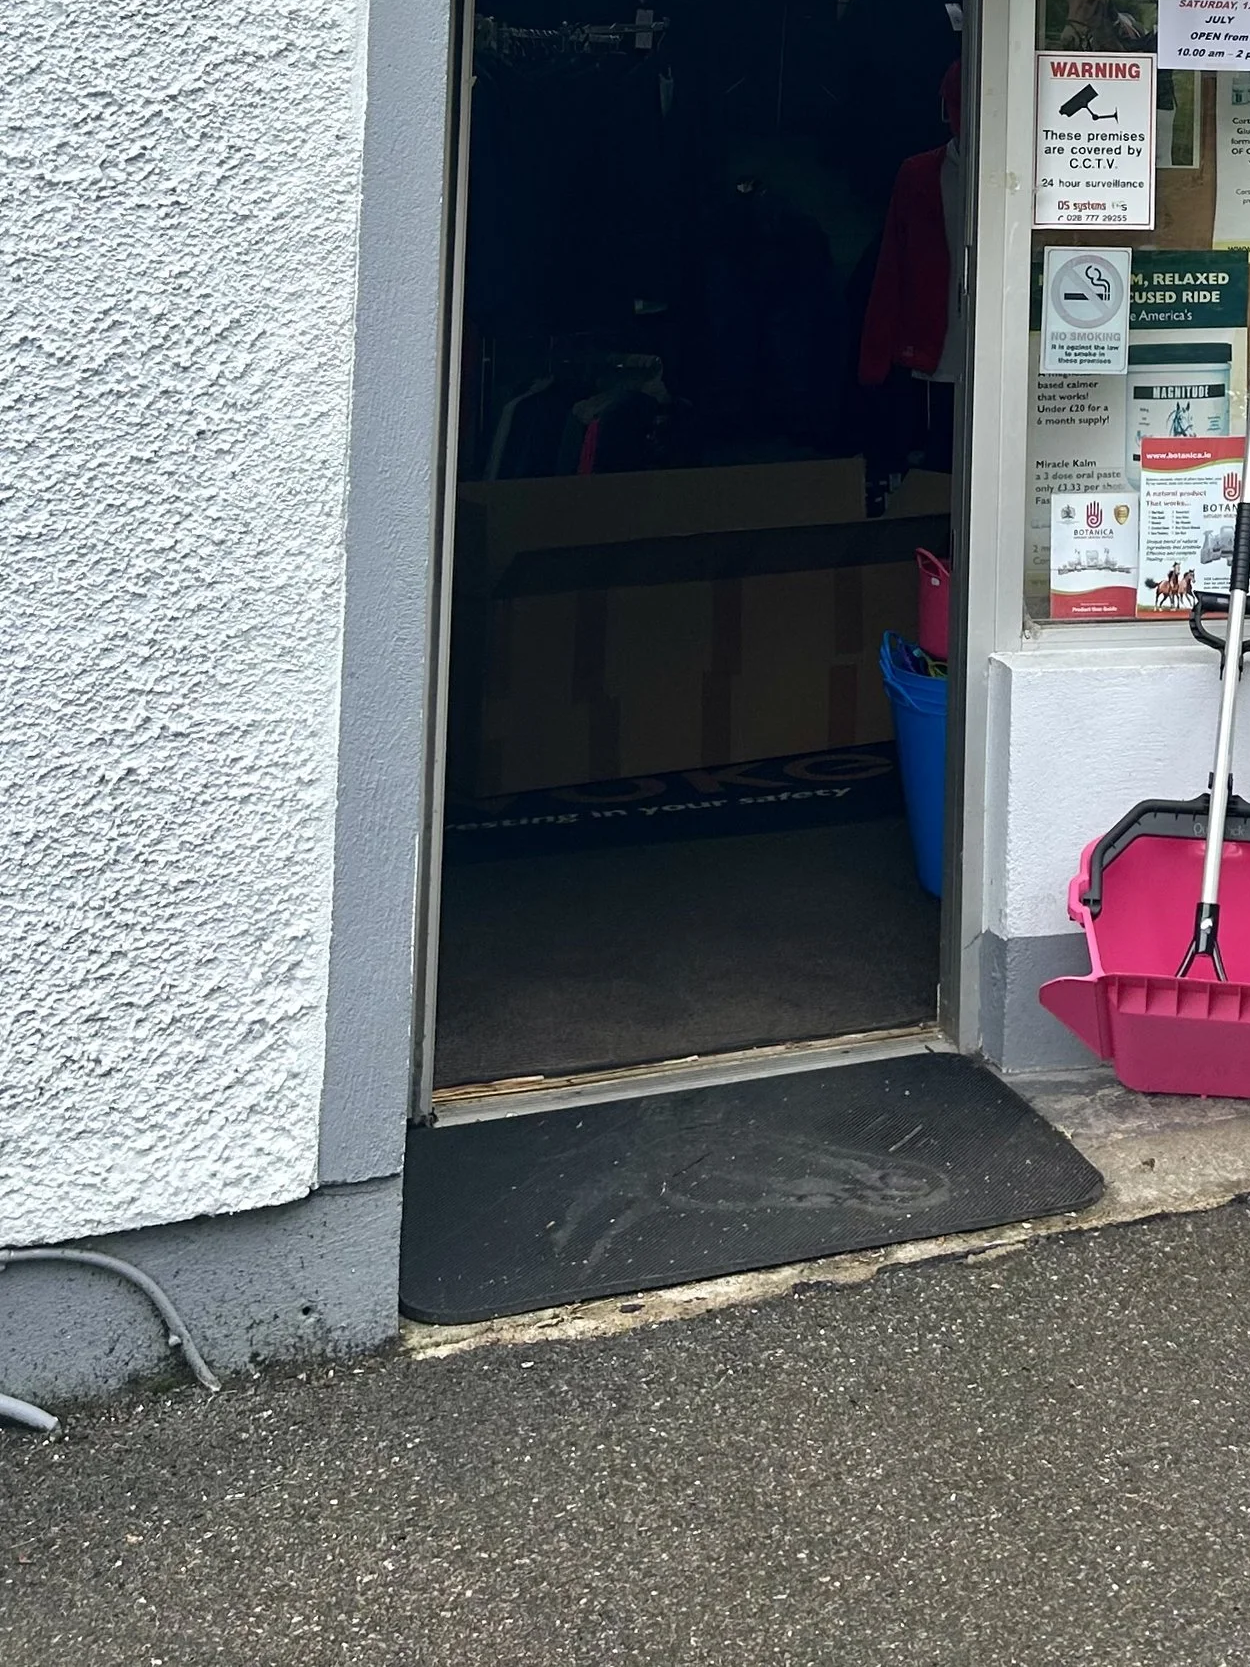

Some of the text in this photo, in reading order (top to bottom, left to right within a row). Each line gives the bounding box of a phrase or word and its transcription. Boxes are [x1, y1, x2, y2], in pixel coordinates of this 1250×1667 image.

[1179, 0, 1238, 10] SATURDAY,
[1190, 32, 1248, 41] OPEN from
[1178, 48, 1206, 57] 10.00
[1208, 49, 1224, 57] am
[1050, 62, 1140, 78] WARNING
[1043, 130, 1145, 142] These premises
[1045, 145, 1142, 157] are covered by
[1069, 158, 1118, 169] C.C.T.V.
[1042, 179, 1144, 188] 24 hour surveillance
[1073, 202, 1106, 212] systems
[1153, 273, 1229, 285] RELAXED
[1129, 292, 1221, 303] CUSED RIDE
[1139, 310, 1192, 321] America's
[1051, 332, 1121, 341] NO SMOKING
[1153, 386, 1209, 399] MAGNITUDE
[1037, 405, 1065, 413] Under
[1069, 405, 1084, 413] £20
[1045, 417, 1076, 425] month
[1079, 416, 1109, 426] supply!
[1036, 459, 1097, 468] Miracle Kalm
[1076, 471, 1094, 479] oral
[1097, 470, 1121, 480] paste
[1035, 483, 1100, 494] only £3.33 per
[593, 809, 628, 818] in
[639, 799, 725, 817] your
[737, 787, 851, 805] safety
